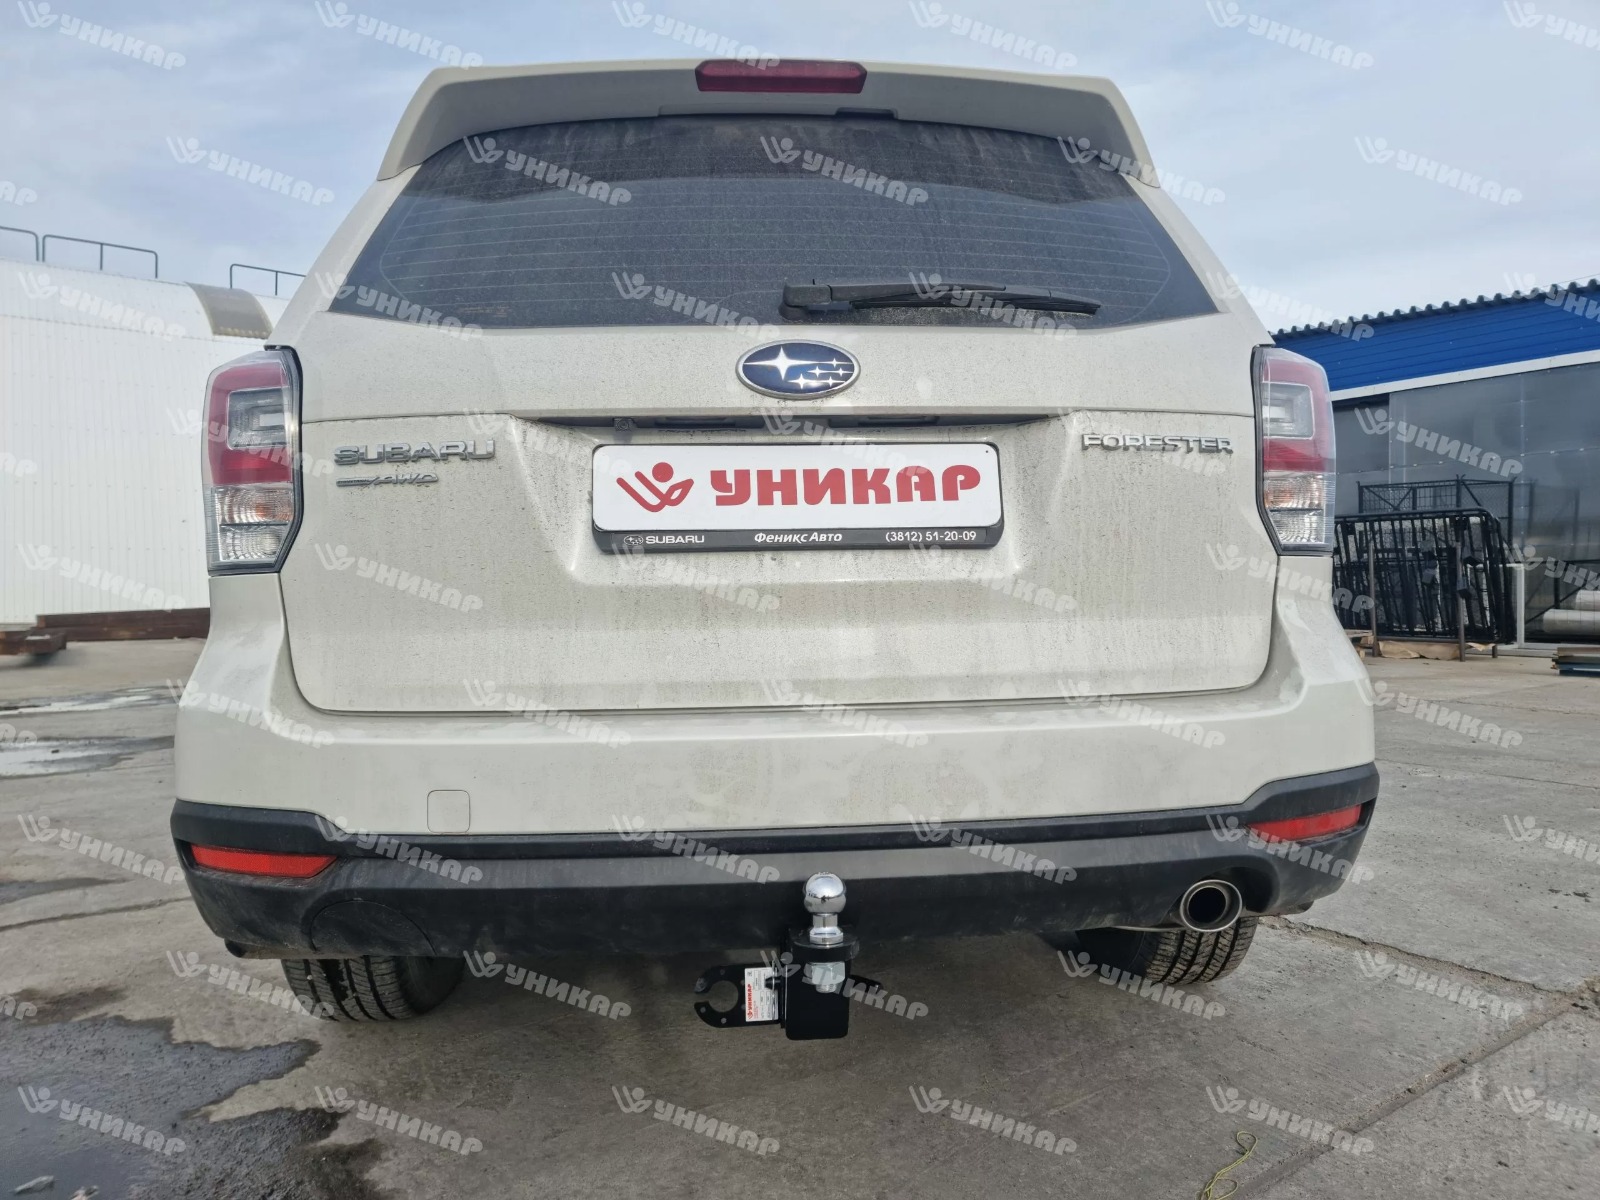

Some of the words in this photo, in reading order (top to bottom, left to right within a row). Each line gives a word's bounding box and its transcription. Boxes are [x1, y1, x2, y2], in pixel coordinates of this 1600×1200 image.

[334, 439, 495, 465] SUBARU
[1082, 434, 1234, 454] FORESTER
[710, 464, 981, 506] УНИКАР
[645, 535, 705, 544] SUBARU
[885, 531, 923, 543] (3812)
[925, 530, 977, 542] 51-20-09
